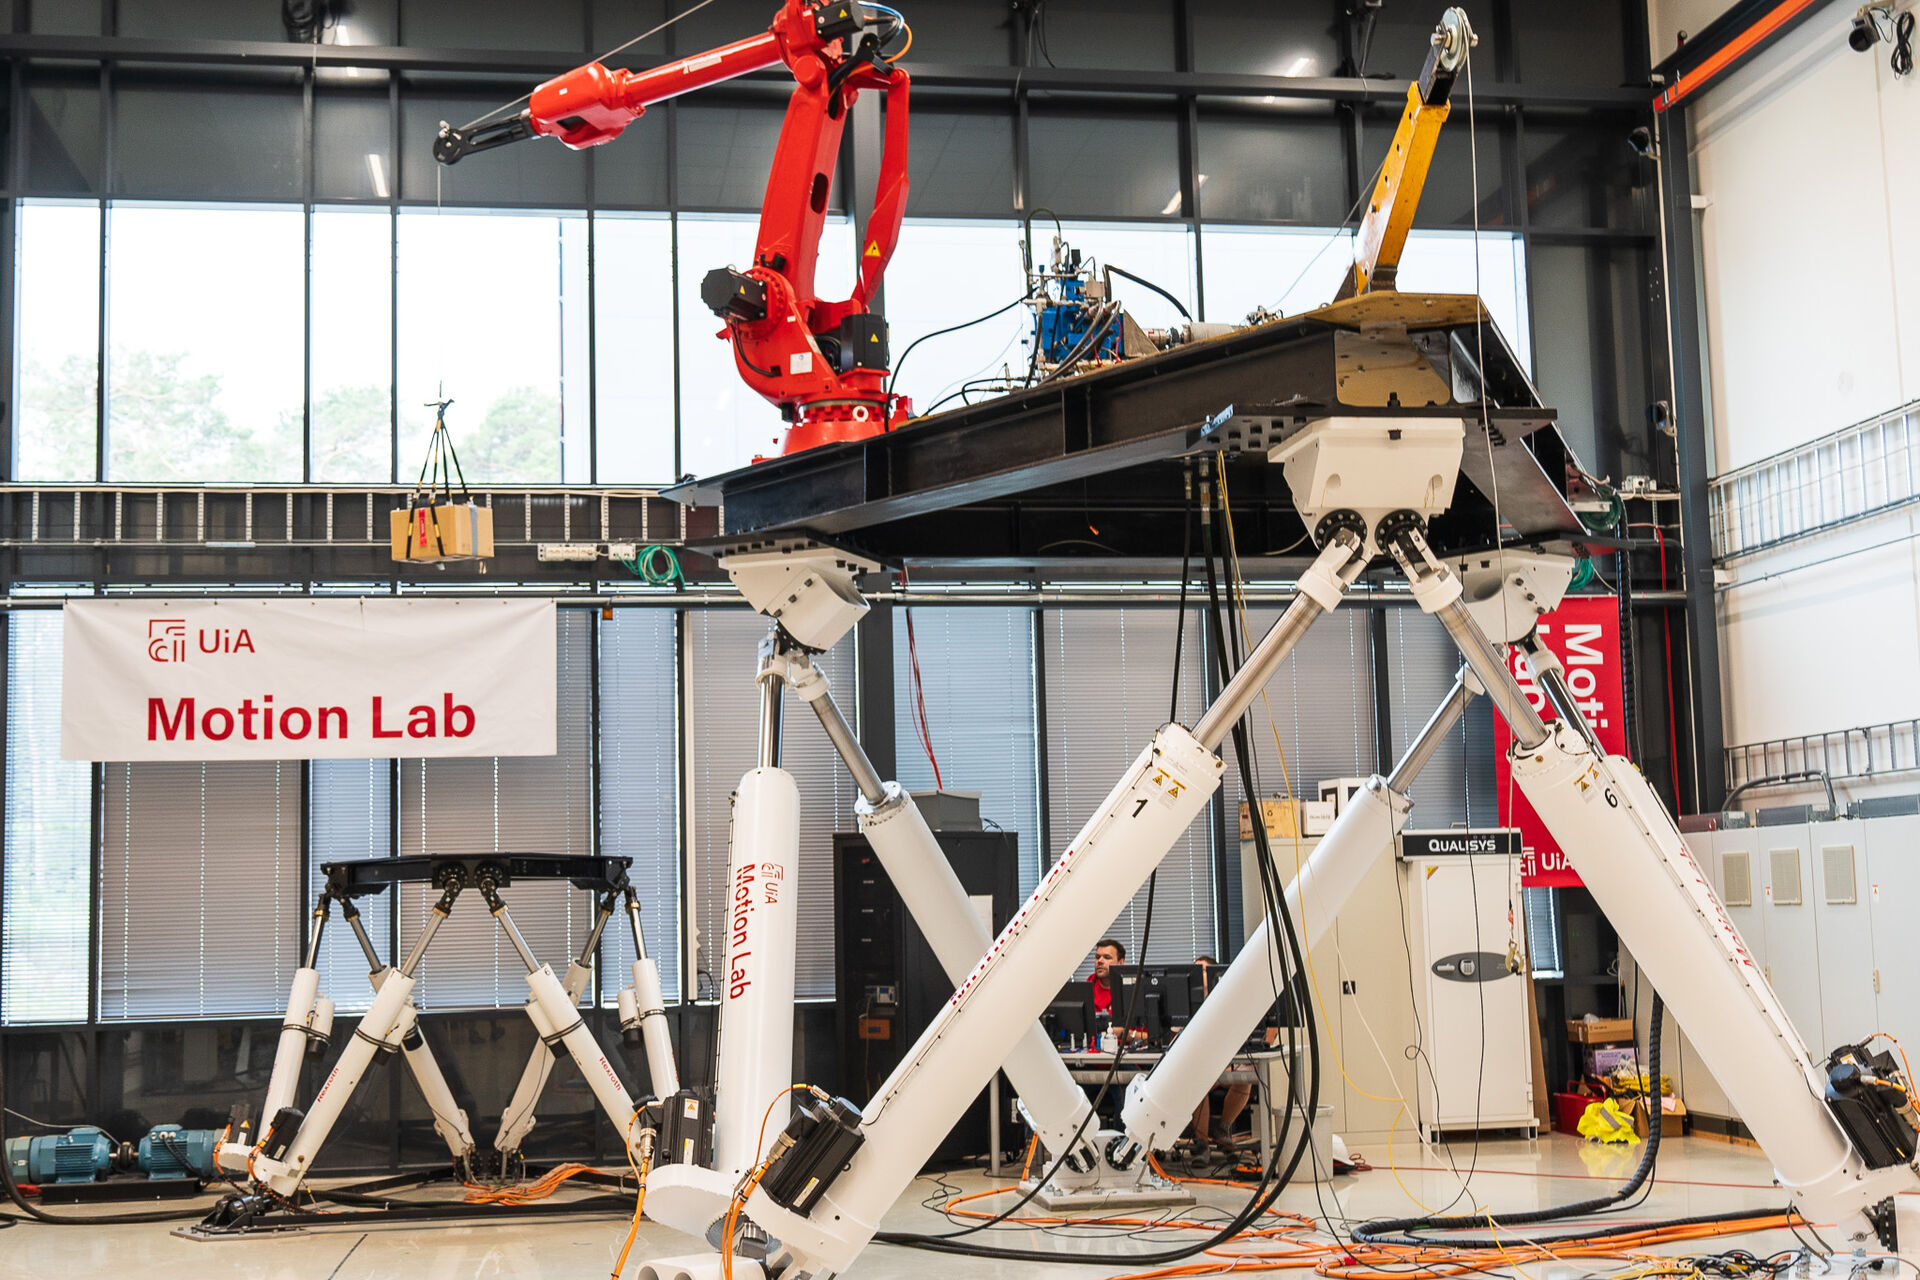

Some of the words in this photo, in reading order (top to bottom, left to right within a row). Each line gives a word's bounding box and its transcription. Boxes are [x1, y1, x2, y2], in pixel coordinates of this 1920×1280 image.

[199, 628, 256, 654] UiA
[1564, 623, 1608, 729] Moti
[147, 694, 349, 742] Motion
[372, 692, 477, 739] Lab
[1132, 799, 1148, 818] 1
[1604, 787, 1618, 808] 6
[1428, 839, 1496, 852] QUALISYS
[1541, 852, 1575, 871] UiA
[732, 863, 756, 948] Motion
[765, 882, 779, 904] UiA
[730, 951, 752, 999] Lab
[599, 1056, 622, 1091] Rexroth
